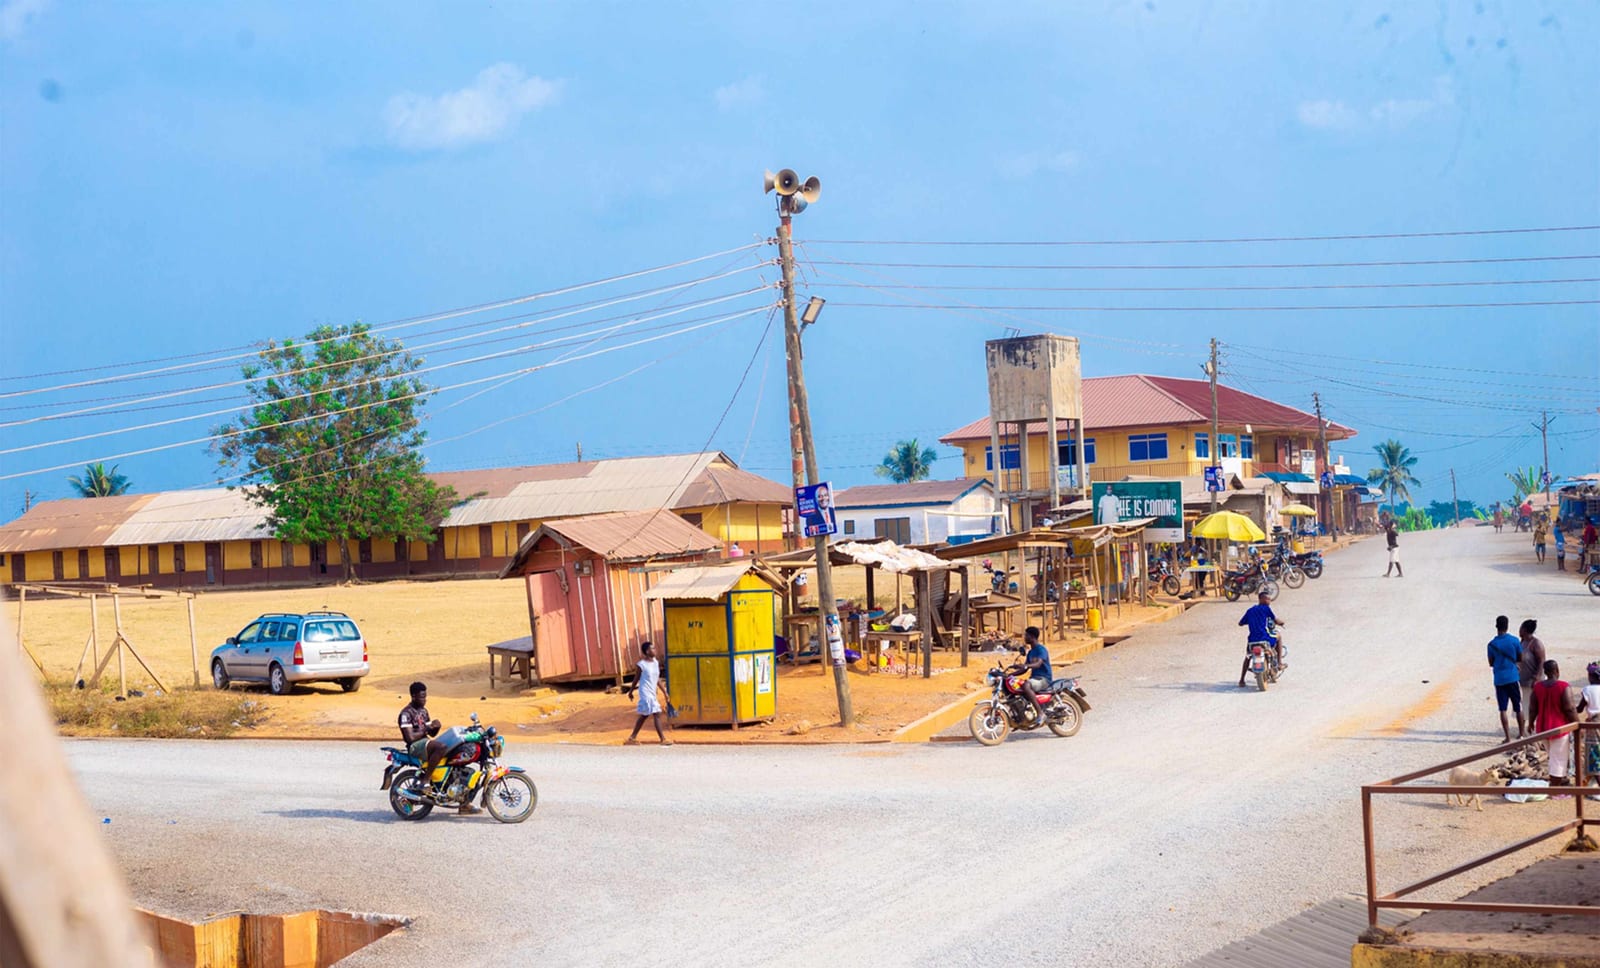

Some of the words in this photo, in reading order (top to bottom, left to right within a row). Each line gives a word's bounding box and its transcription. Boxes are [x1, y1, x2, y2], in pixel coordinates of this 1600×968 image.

[1119, 499, 1131, 516] HE
[1134, 499, 1142, 516] IS
[1144, 499, 1176, 516] COMING
